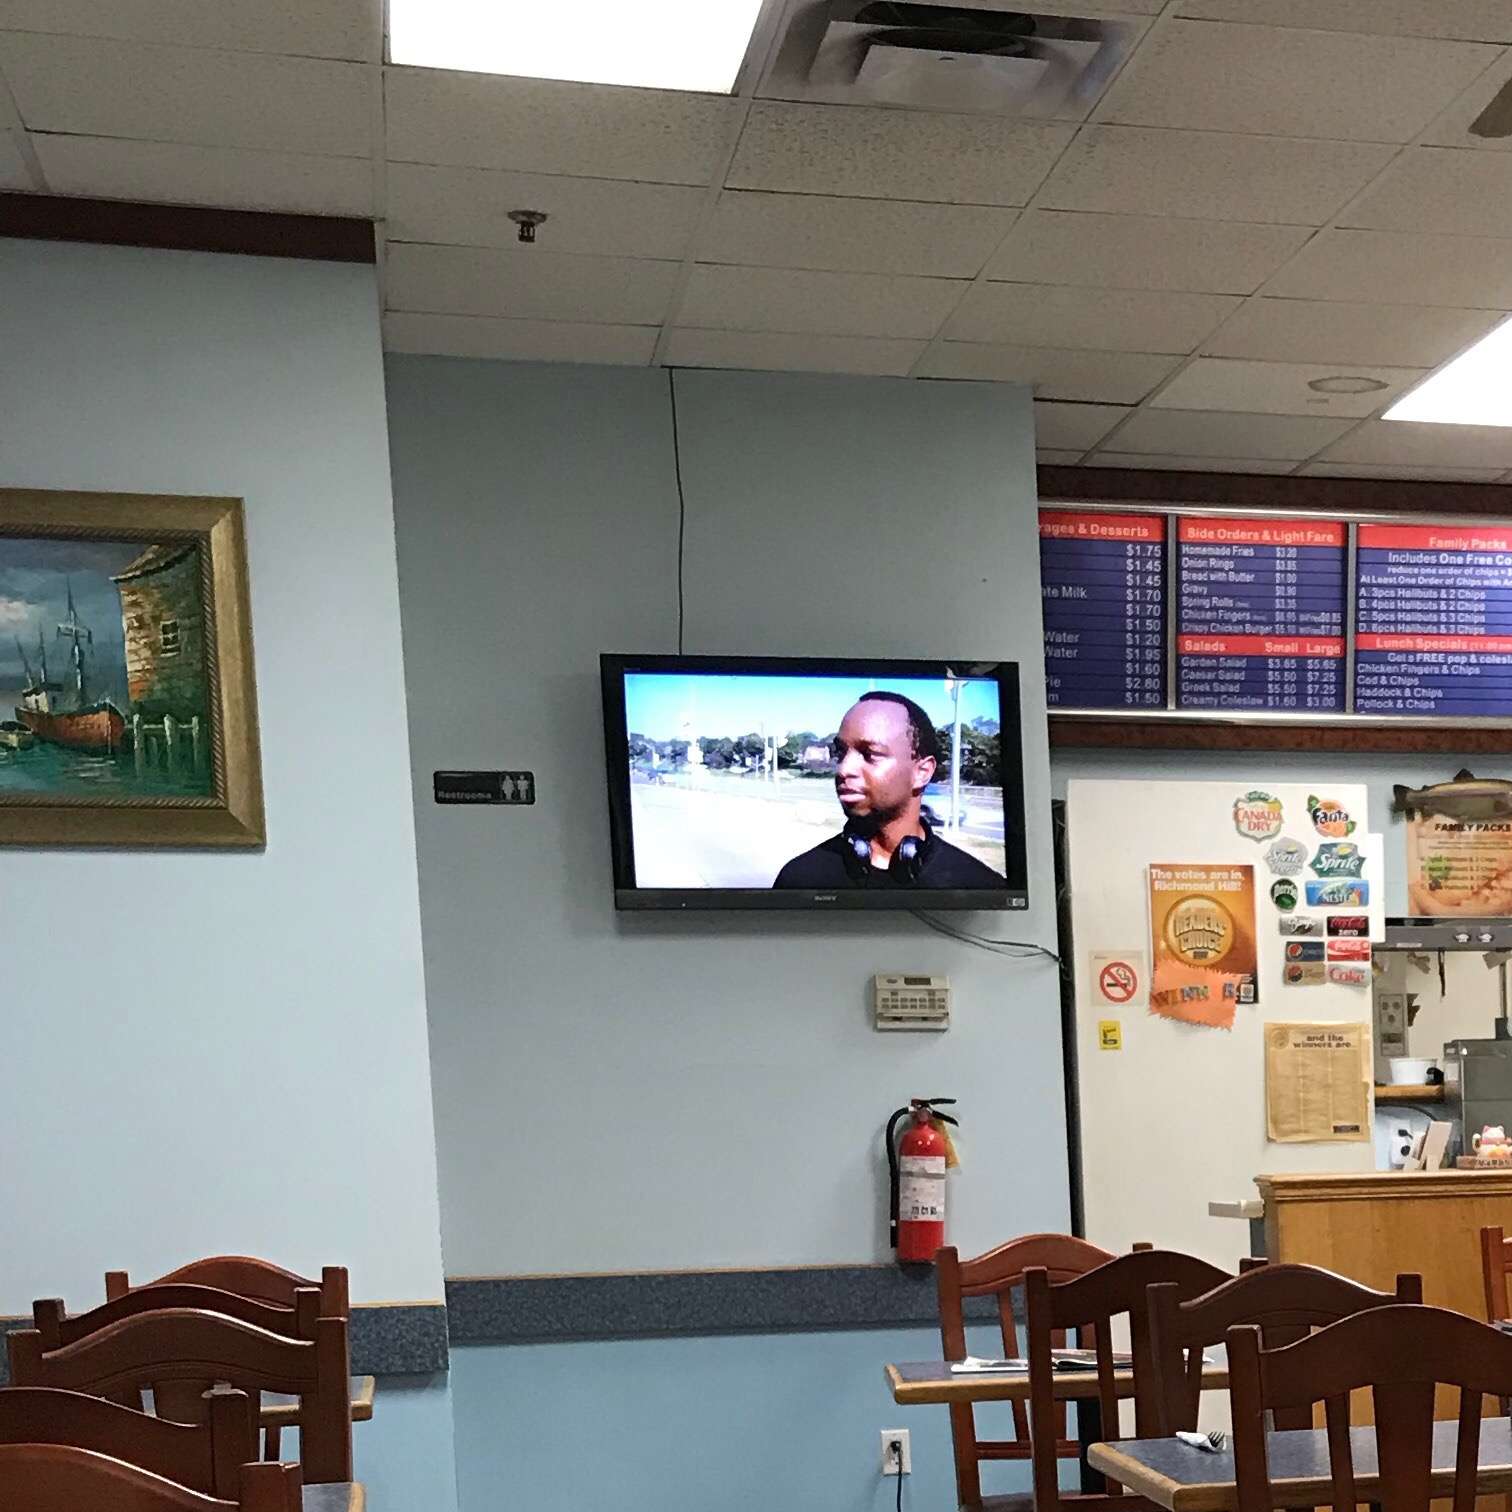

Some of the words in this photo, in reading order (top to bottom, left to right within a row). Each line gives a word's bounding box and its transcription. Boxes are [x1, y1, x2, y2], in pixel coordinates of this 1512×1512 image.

[1078, 523, 1087, 535] &
[1090, 524, 1149, 537] Desserts
[1187, 527, 1215, 539] Side
[1217, 528, 1260, 541] Orders
[1261, 529, 1271, 541] &
[1273, 530, 1304, 544] Light
[1306, 532, 1335, 543] Fare
[1429, 537, 1469, 550] Family
[1471, 539, 1507, 550] Packs
[1126, 544, 1161, 557] $1.75
[1232, 546, 1255, 557] Fries
[1181, 557, 1208, 568] Onion
[1209, 558, 1235, 570] Rings
[1388, 552, 1437, 564] Includes
[1439, 553, 1464, 565] One
[1466, 554, 1493, 565] Free
[1126, 559, 1161, 572] $1.45
[1126, 574, 1161, 587] $1.45
[1181, 570, 1208, 581] Bread
[1210, 572, 1227, 582] with
[1228, 571, 1255, 583] Butter
[1419, 577, 1444, 586] Order
[1456, 578, 1482, 588] Chips
[1061, 586, 1087, 598] Milk
[1126, 588, 1161, 602] $1.70
[1181, 583, 1208, 595] Gravy
[1211, 596, 1234, 608] Rolls
[1458, 590, 1486, 602] Chips
[1126, 604, 1161, 617] $1.70
[1458, 601, 1486, 613] Chips
[1218, 609, 1251, 622] Fingers
[1458, 613, 1486, 625] Chips
[1125, 618, 1160, 631] $1.50
[1210, 623, 1243, 635] Chicken
[1245, 623, 1273, 636] Burger
[1458, 624, 1486, 636] Chips
[1125, 633, 1160, 646] $1.20
[1376, 638, 1414, 649] Lunch
[1416, 639, 1468, 651] Specials
[1125, 648, 1160, 661] $1.95
[1184, 640, 1226, 651] Salads
[1264, 642, 1299, 653] Small
[1306, 643, 1341, 656] Large
[1181, 656, 1217, 668] Garden
[1218, 657, 1248, 668] Salad
[1416, 654, 1445, 664] FREE
[1447, 656, 1468, 667] pop
[1125, 662, 1160, 675] $1.60
[1357, 664, 1399, 674] Chicken
[1400, 664, 1439, 676] Fingers
[1441, 665, 1449, 675] &
[1450, 665, 1480, 676] Chips
[1181, 670, 1217, 681] Caesar
[1218, 670, 1246, 682] Salad
[1357, 675, 1379, 686] Cod
[1380, 676, 1388, 686] &
[1389, 676, 1420, 688] Chips
[1181, 682, 1210, 694] Greek
[1211, 683, 1241, 694] Salad
[1356, 688, 1402, 698] Haddock
[1413, 688, 1443, 699] Chips
[1125, 691, 1160, 704] $1.50
[1356, 699, 1394, 709] Pollock
[1396, 700, 1404, 709] &
[1406, 699, 1435, 710] Chips
[1234, 807, 1283, 822] CANADA
[1312, 808, 1349, 826] Fanta
[1247, 821, 1272, 832] DRY
[1434, 823, 1474, 832] FAMILY
[1476, 823, 1512, 832] PACKS
[1316, 852, 1360, 872] Sprite
[1151, 869, 1173, 880] The
[1174, 872, 1207, 880] votes
[1209, 872, 1229, 880] are
[1154, 880, 1216, 891] Richmond
[1338, 928, 1359, 937] zero
[1329, 968, 1366, 983] Coke
[1306, 1033, 1326, 1042] and
[1327, 1033, 1345, 1042] the
